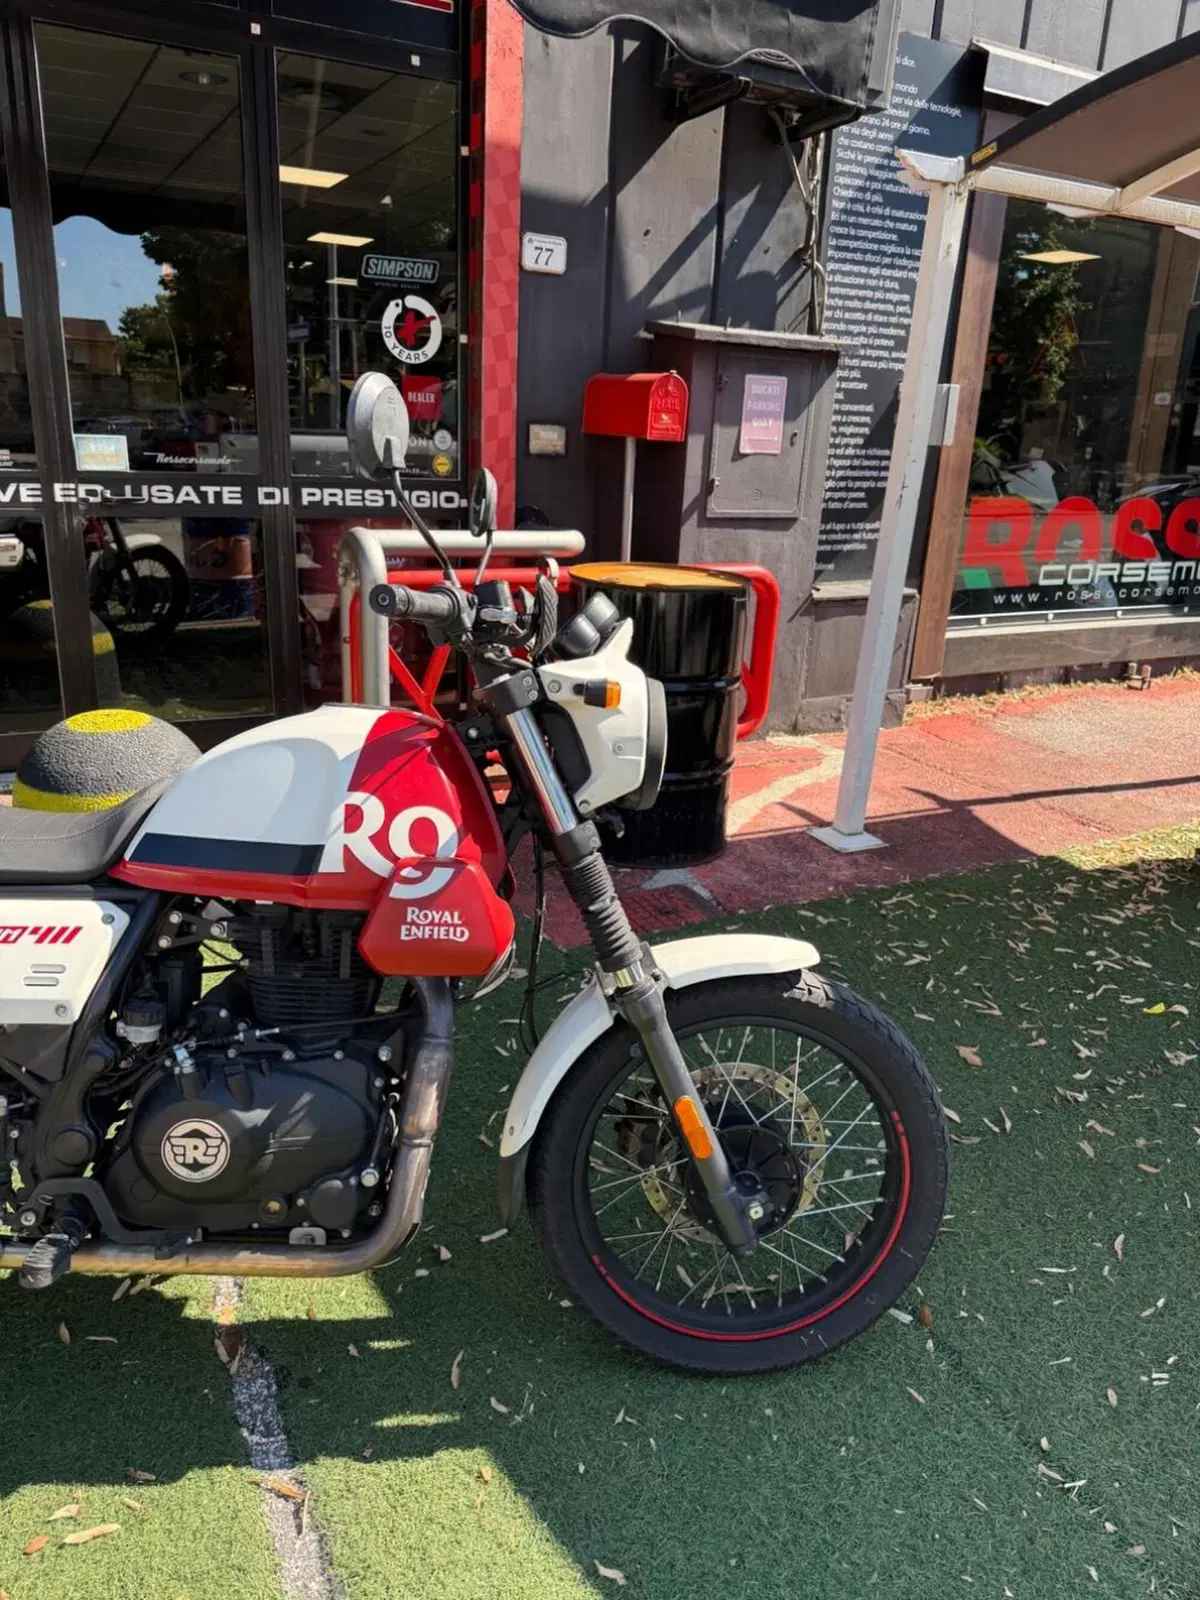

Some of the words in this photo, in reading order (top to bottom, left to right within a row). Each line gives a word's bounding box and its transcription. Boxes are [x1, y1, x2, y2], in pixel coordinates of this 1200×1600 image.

[882, 118, 890, 128] 24
[908, 124, 931, 136] giorno.
[534, 246, 554, 266] 77
[367, 258, 434, 280] SIMPSON
[391, 343, 429, 362] YEARS
[407, 392, 436, 404] DEALER
[752, 384, 780, 396] DUCATI
[746, 400, 781, 412] PARKING
[53, 483, 104, 503] ED
[124, 485, 244, 505] USATE
[258, 486, 290, 505] DI
[406, 906, 462, 925] ROYAL
[400, 924, 470, 942] ENFIELD
